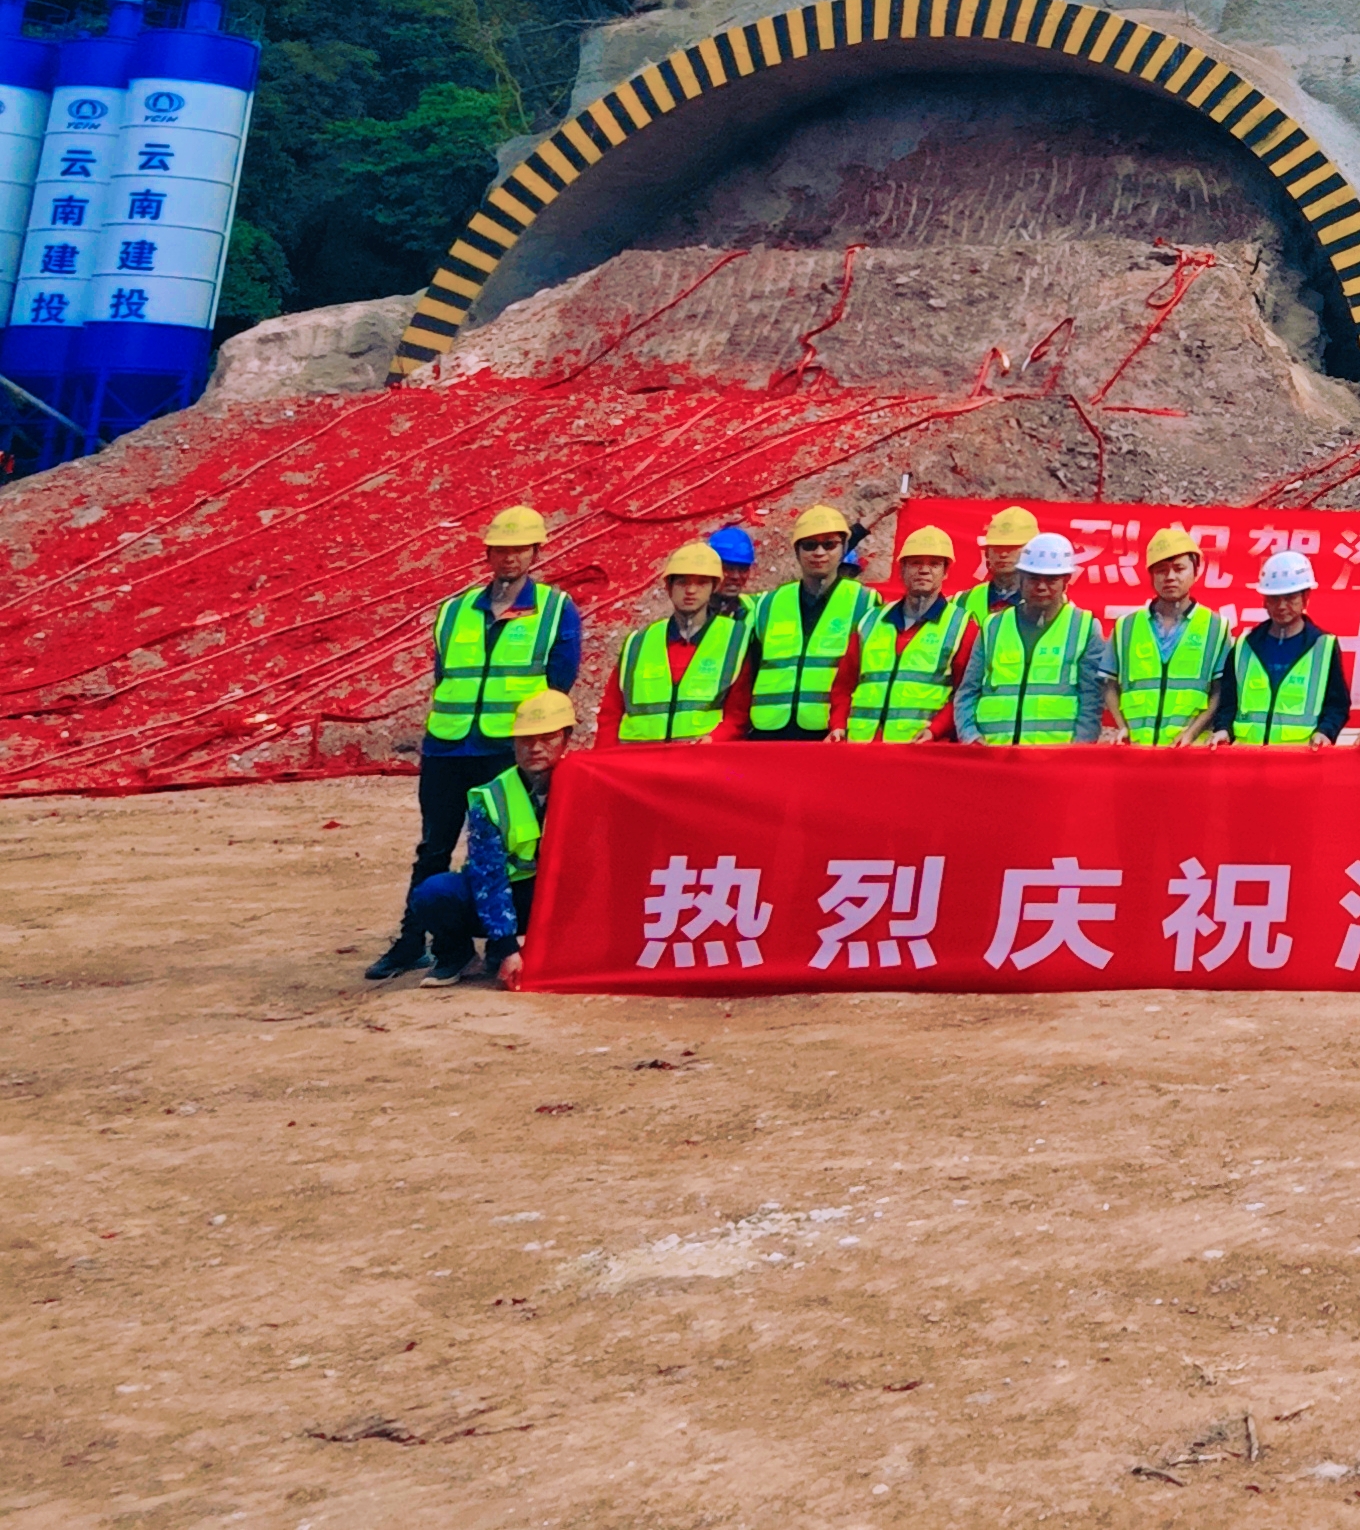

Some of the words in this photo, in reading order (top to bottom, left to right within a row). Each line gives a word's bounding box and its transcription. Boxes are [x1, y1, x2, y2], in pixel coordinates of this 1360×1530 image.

[31, 149, 97, 324] 云南建投
[110, 142, 175, 321] 云南建投
